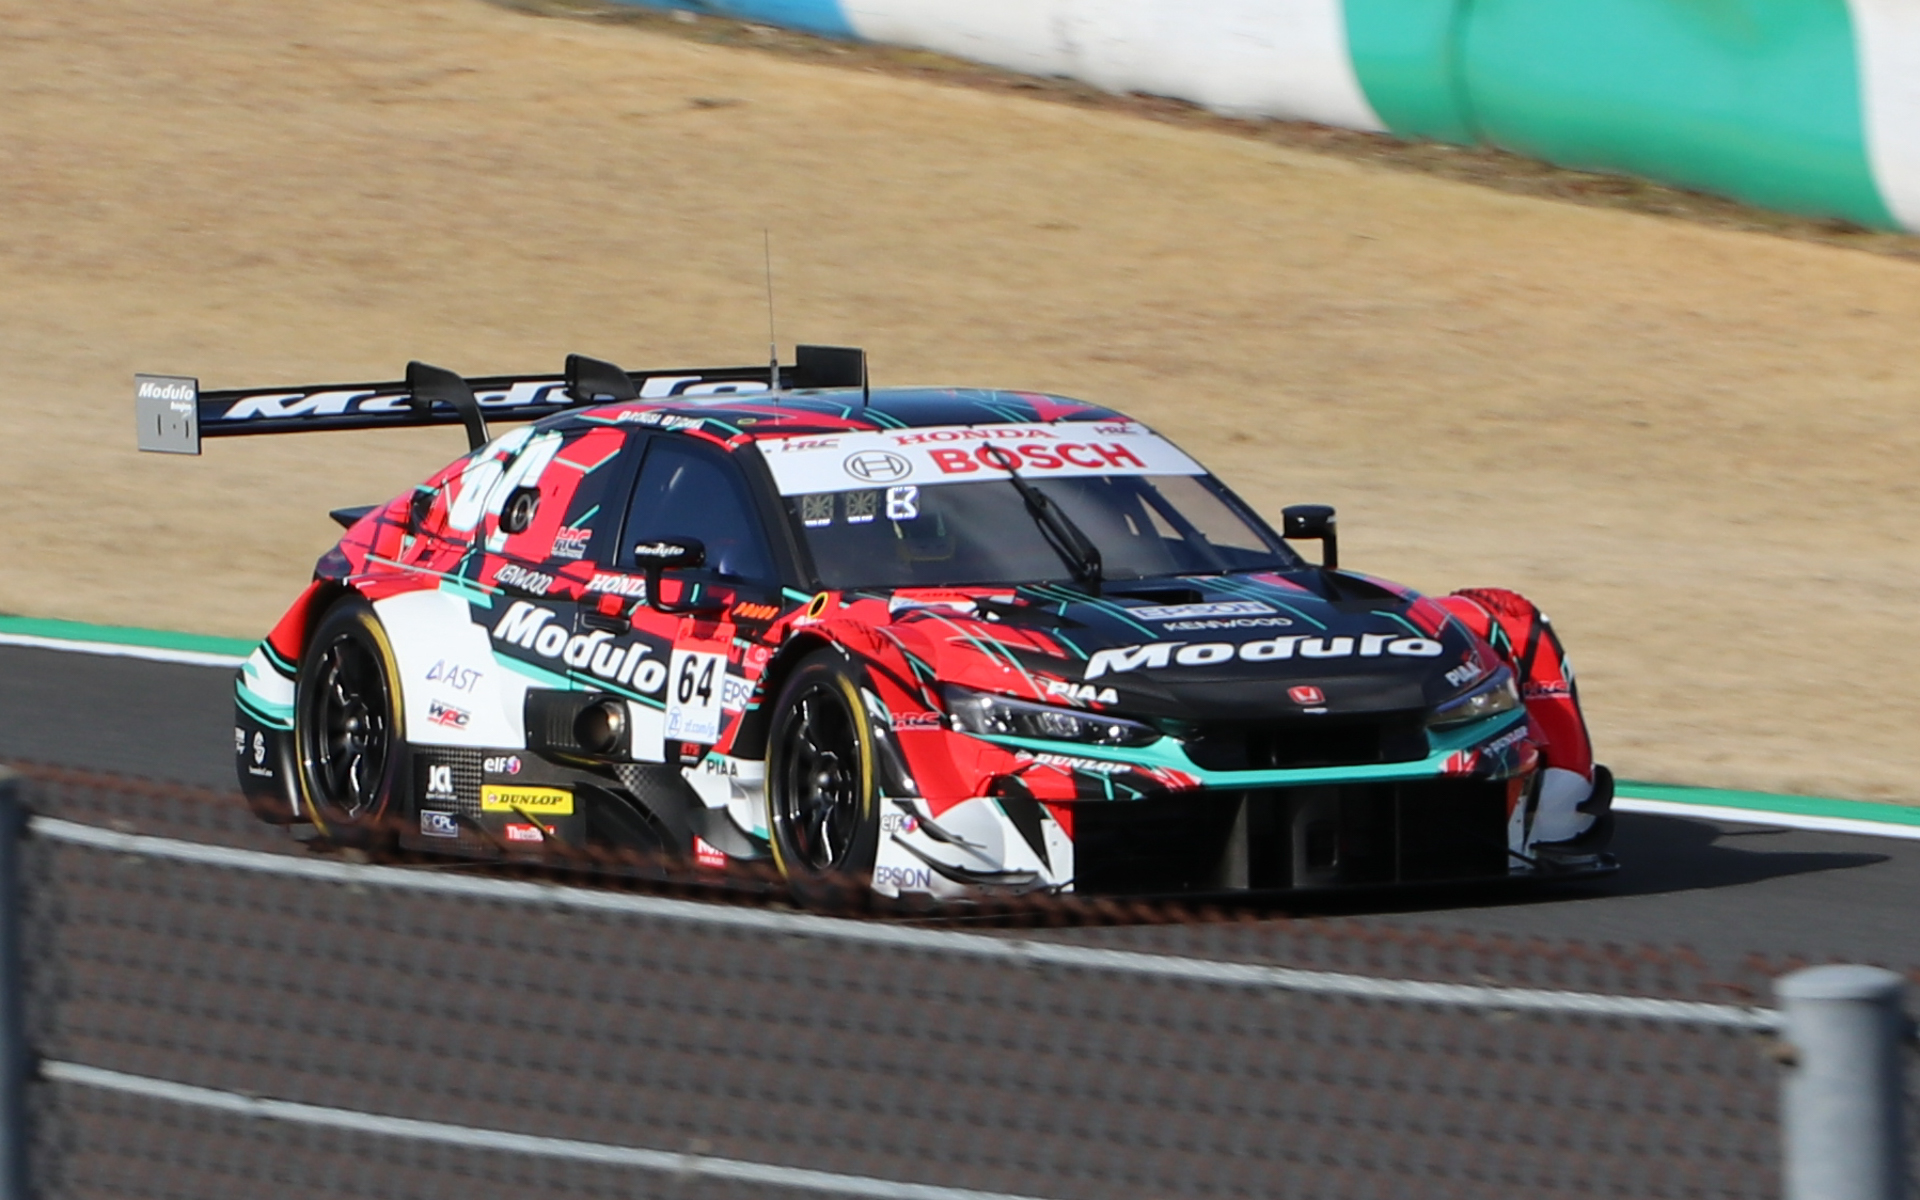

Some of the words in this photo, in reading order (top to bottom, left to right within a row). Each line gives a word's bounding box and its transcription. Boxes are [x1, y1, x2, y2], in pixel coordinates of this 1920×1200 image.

[138, 382, 194, 401] Modulo
[892, 429, 1059, 446] HONDA
[927, 443, 1147, 474] BOSCH
[493, 563, 554, 596] KENWOOD
[584, 573, 646, 598] HOND
[1135, 602, 1268, 618] EPSON
[1163, 618, 1293, 632] KENWOOD
[493, 600, 668, 694] Modulo
[1084, 633, 1443, 680] Modulo
[677, 653, 718, 707] 64
[1046, 680, 1118, 704] PIAA
[483, 757, 507, 773] elf
[706, 760, 738, 777] PIAA
[1033, 753, 1132, 774] DUNLOP
[500, 793, 563, 806] DUNLOP
[881, 813, 903, 833] elf
[876, 866, 931, 888] EPSON
